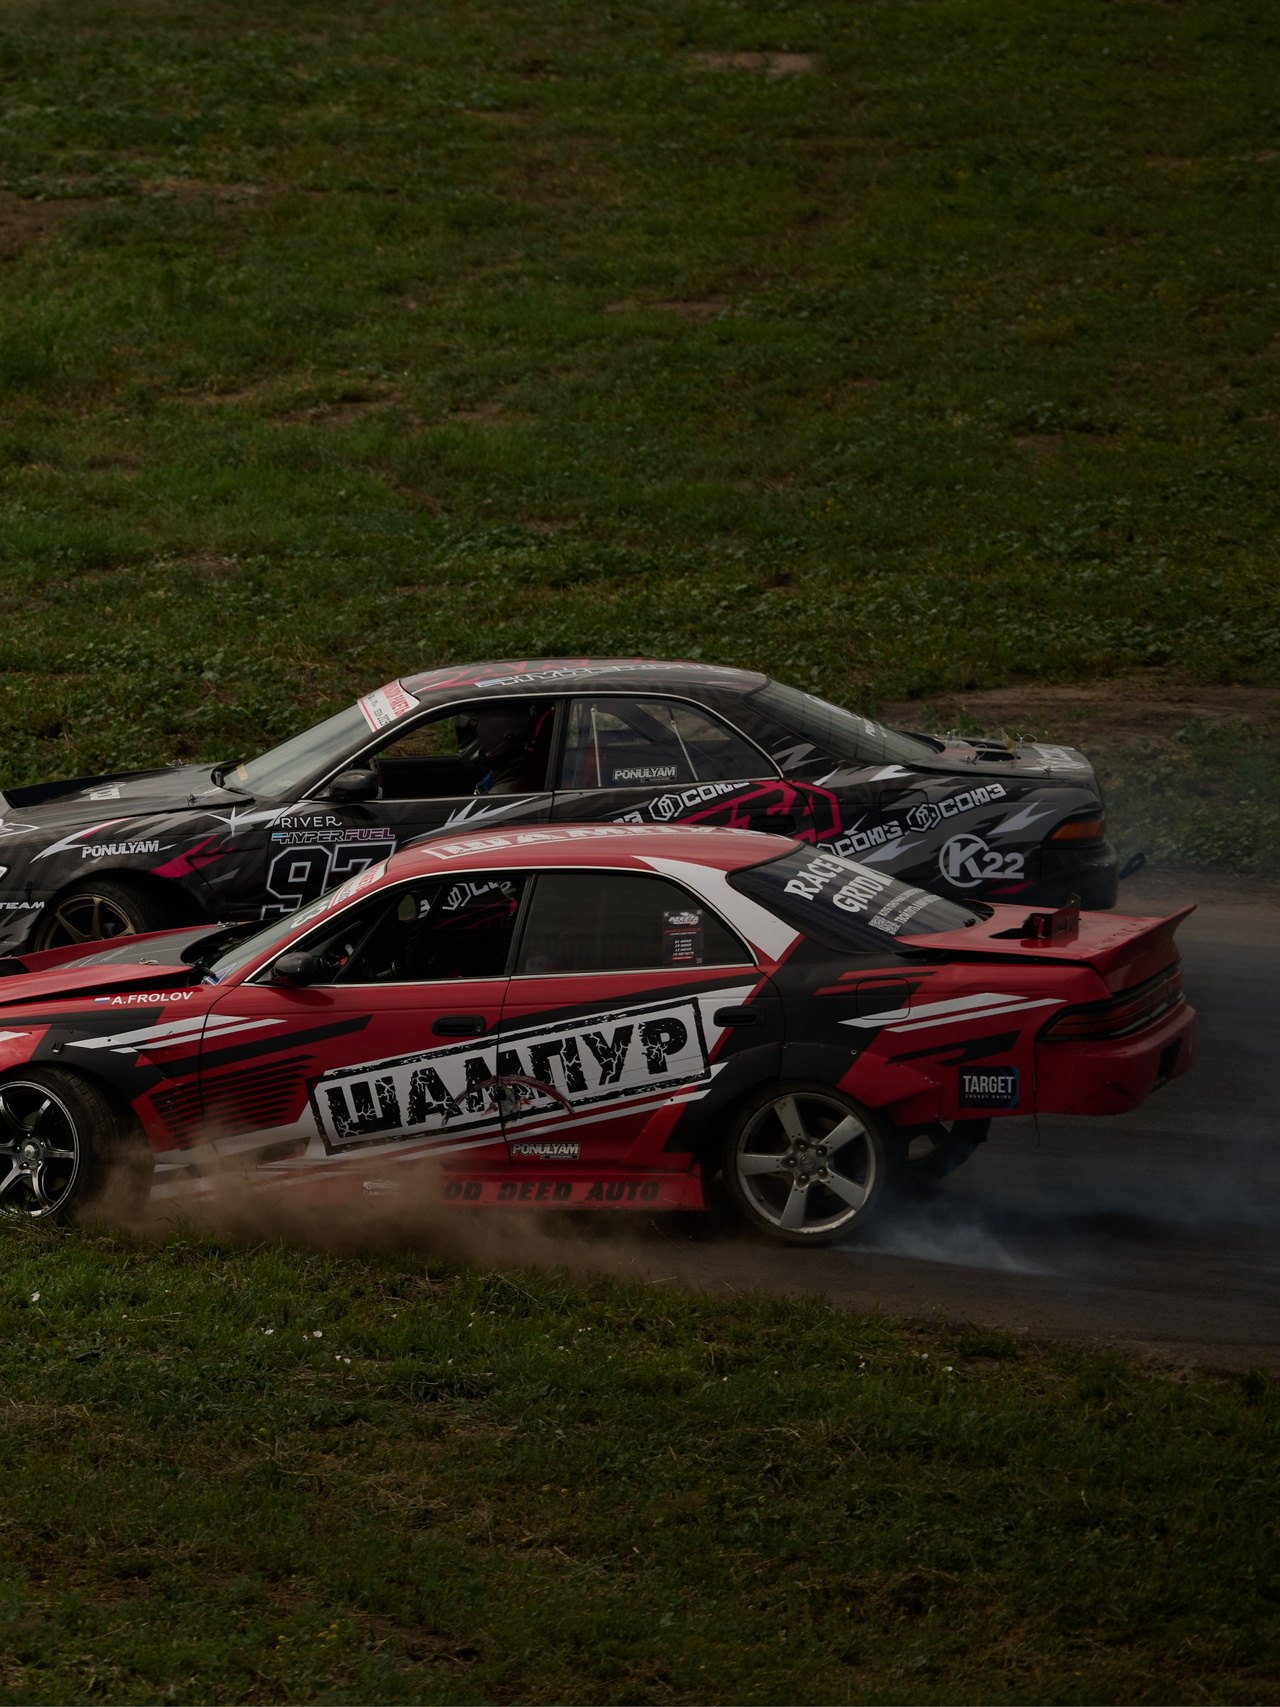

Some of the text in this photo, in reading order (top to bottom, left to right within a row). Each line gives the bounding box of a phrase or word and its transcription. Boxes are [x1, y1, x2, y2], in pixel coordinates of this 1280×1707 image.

[614, 766, 676, 780] PONULYAM
[280, 816, 343, 829] RIVER
[81, 840, 160, 859] PONULYAM
[944, 838, 1025, 883] K22
[783, 856, 845, 901] RACE
[832, 875, 885, 913] GRID
[111, 991, 195, 1006] A.FROLOV
[325, 1016, 688, 1139] ШАМПУР
[962, 1075, 1015, 1093] TARGET
[512, 1143, 579, 1155] PONULYAM
[497, 1181, 573, 1201] DEED
[585, 1181, 660, 1201] AUTO
